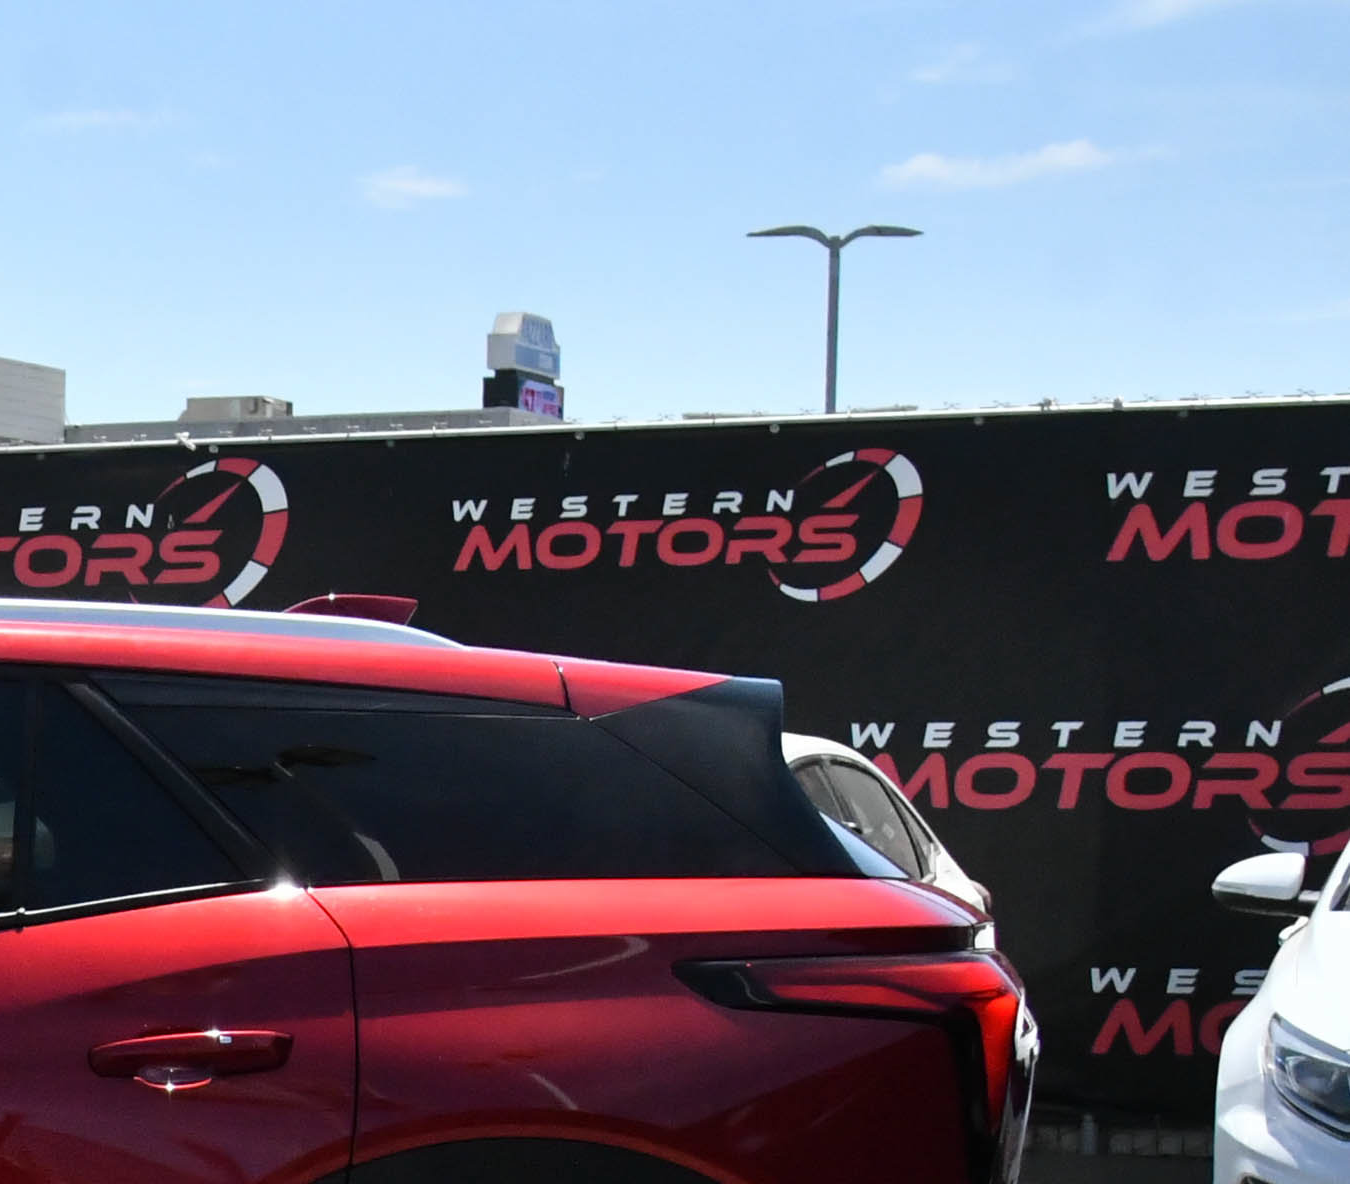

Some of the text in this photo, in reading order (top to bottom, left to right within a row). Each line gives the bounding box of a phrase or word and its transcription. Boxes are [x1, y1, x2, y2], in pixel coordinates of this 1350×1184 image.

[452, 489, 795, 522] WESTERN
[453, 514, 860, 571] MOTORS
[850, 720, 1283, 749] WESTERN
[869, 752, 1350, 811] MOTORS
